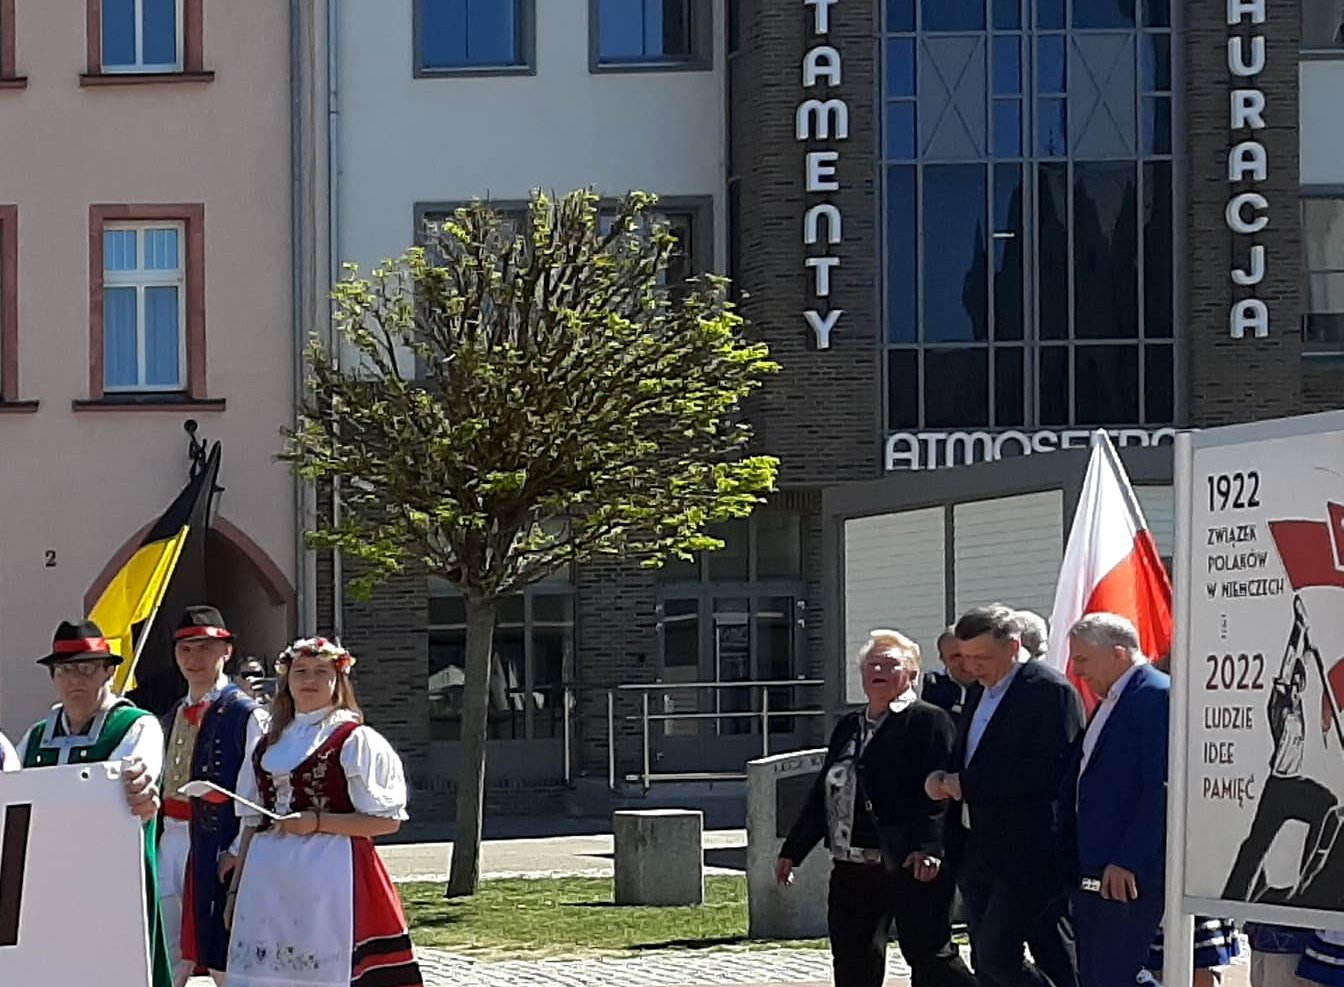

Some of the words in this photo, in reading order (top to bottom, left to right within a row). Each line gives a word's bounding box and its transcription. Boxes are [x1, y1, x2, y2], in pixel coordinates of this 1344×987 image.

[796, 0, 849, 349] TAMENTY
[1208, 471, 1260, 511] 1922
[45, 550, 56, 568] 2
[1208, 549, 1268, 573] POLAKÓW
[1206, 583, 1217, 598] W
[1205, 653, 1264, 690] 2022
[1205, 707, 1254, 729] LUDZIE
[1204, 742, 1234, 764] IDEE
[1203, 774, 1255, 808] PAMIĘĆ
